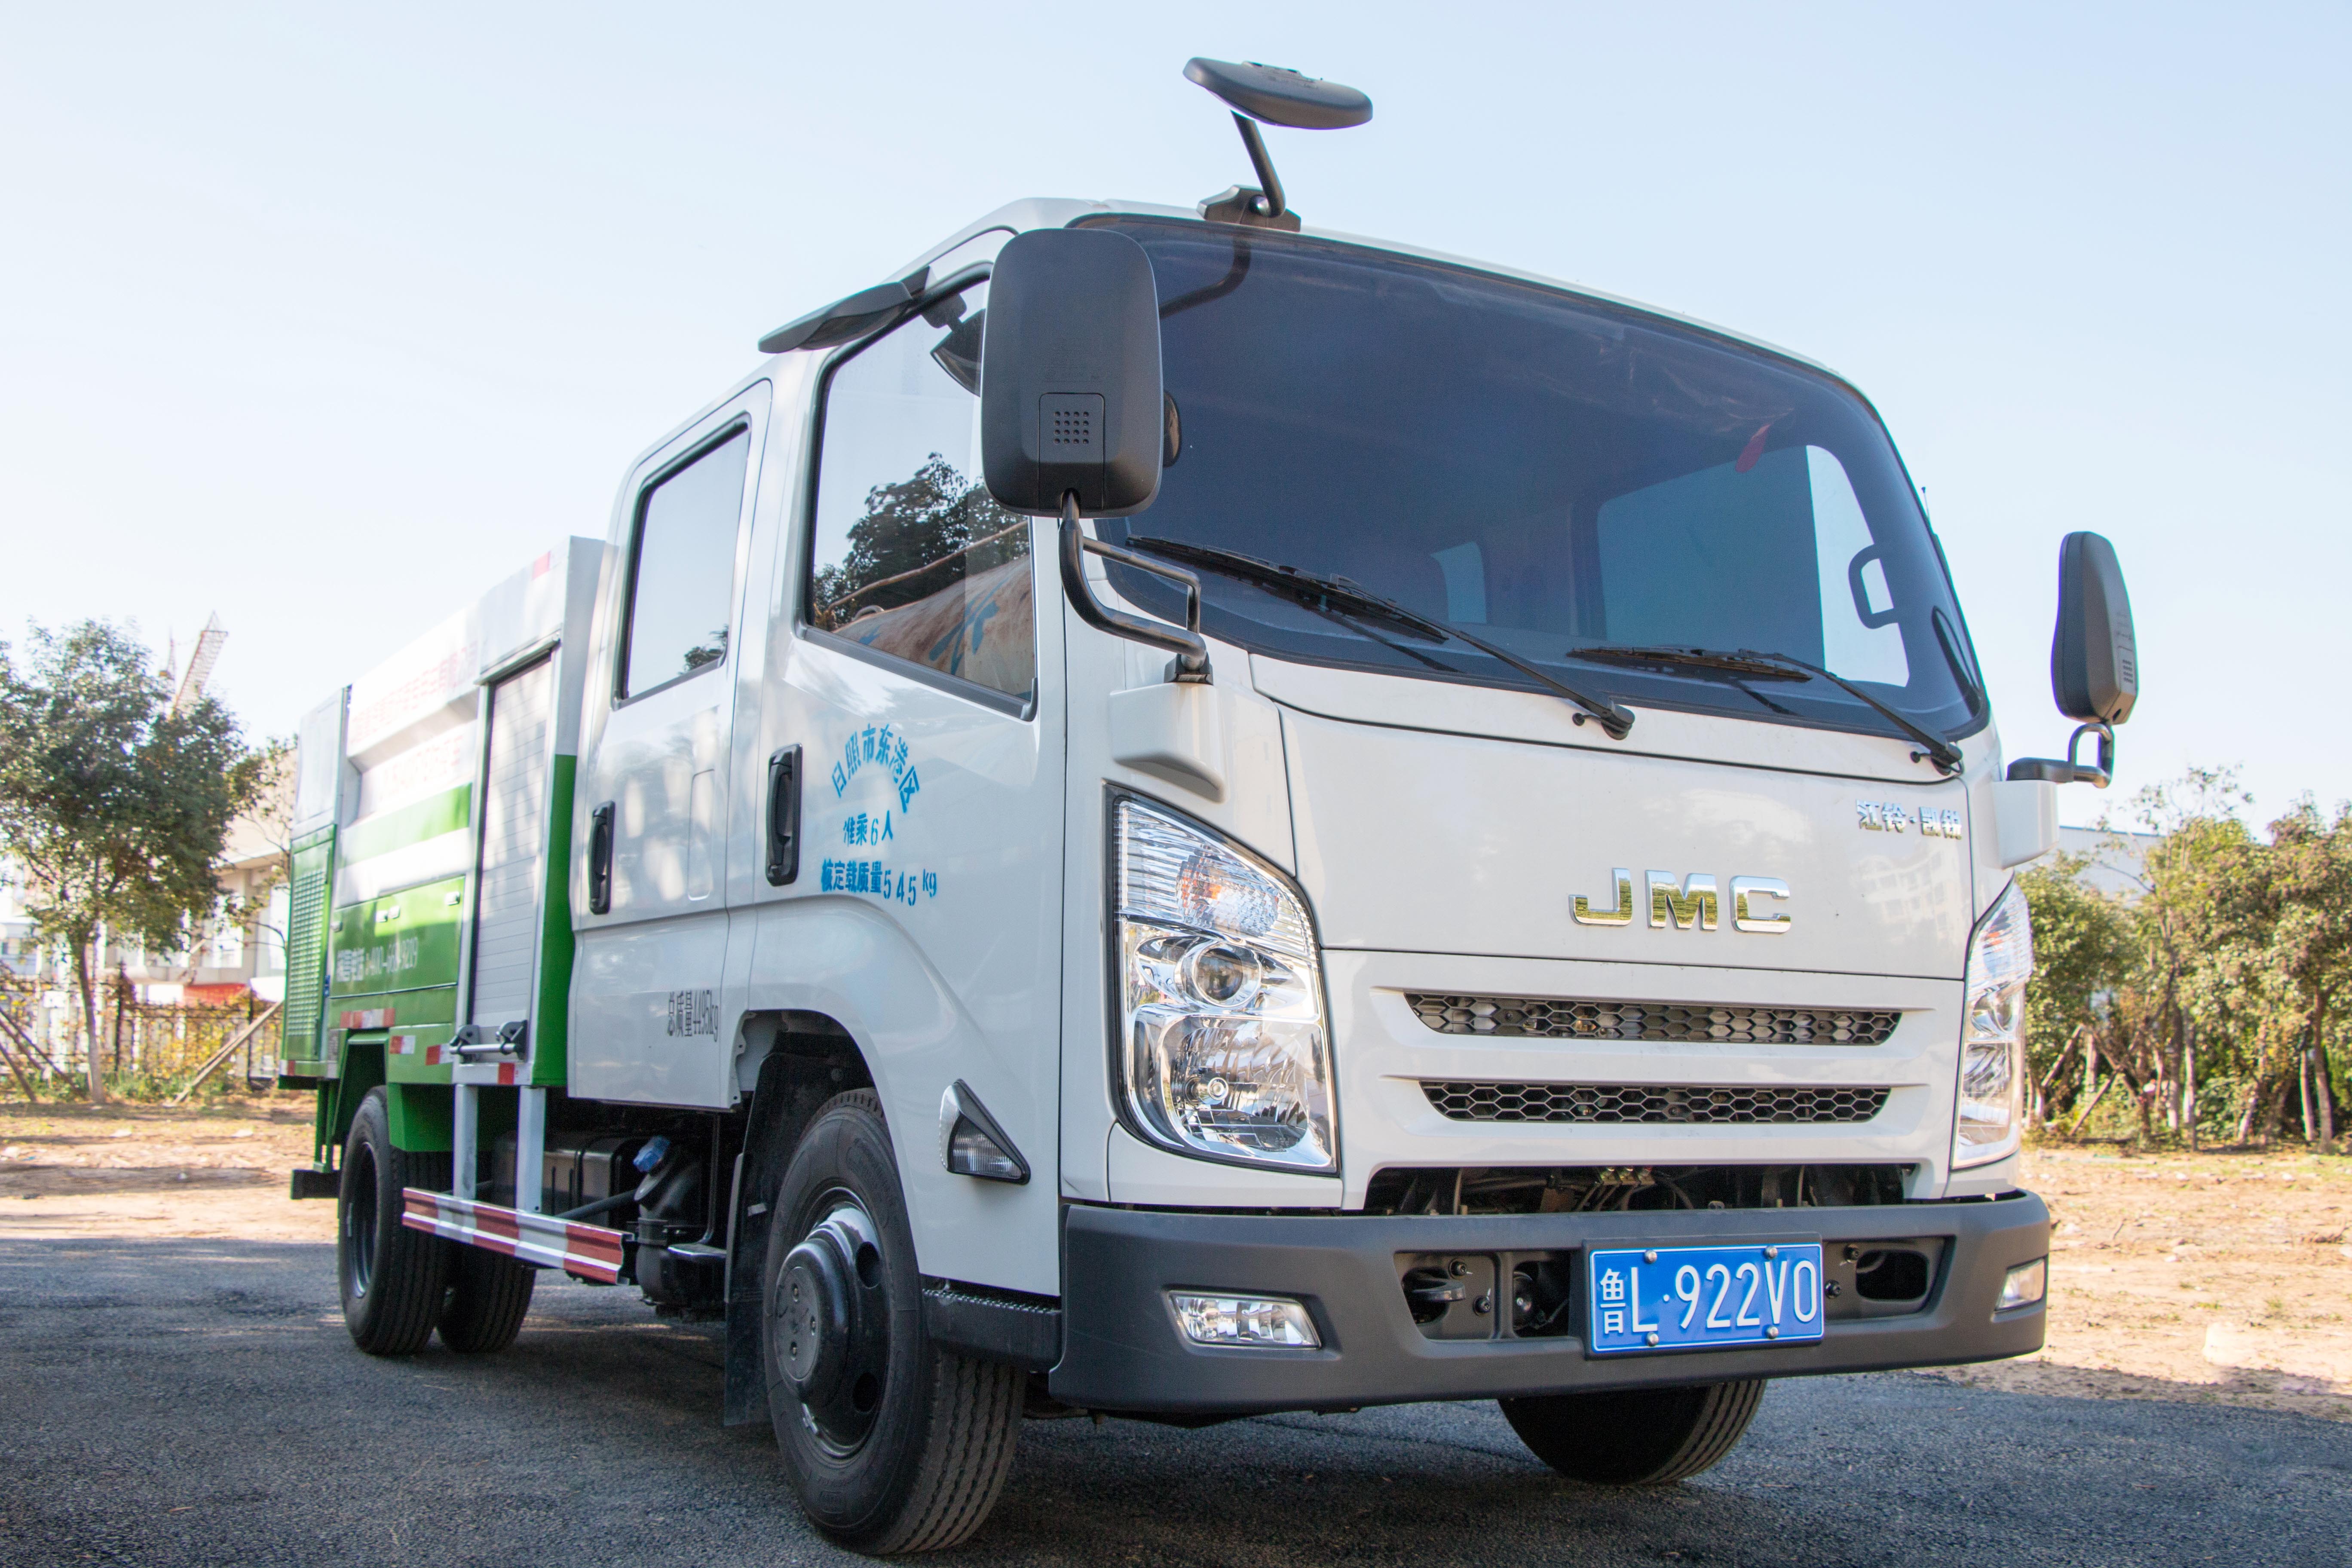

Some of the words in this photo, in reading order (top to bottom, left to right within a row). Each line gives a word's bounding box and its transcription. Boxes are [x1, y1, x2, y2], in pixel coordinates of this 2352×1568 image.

[831, 723, 920, 813] 日照市东港区
[843, 810, 893, 846] 准乘6人
[1569, 867, 1792, 933] JMC
